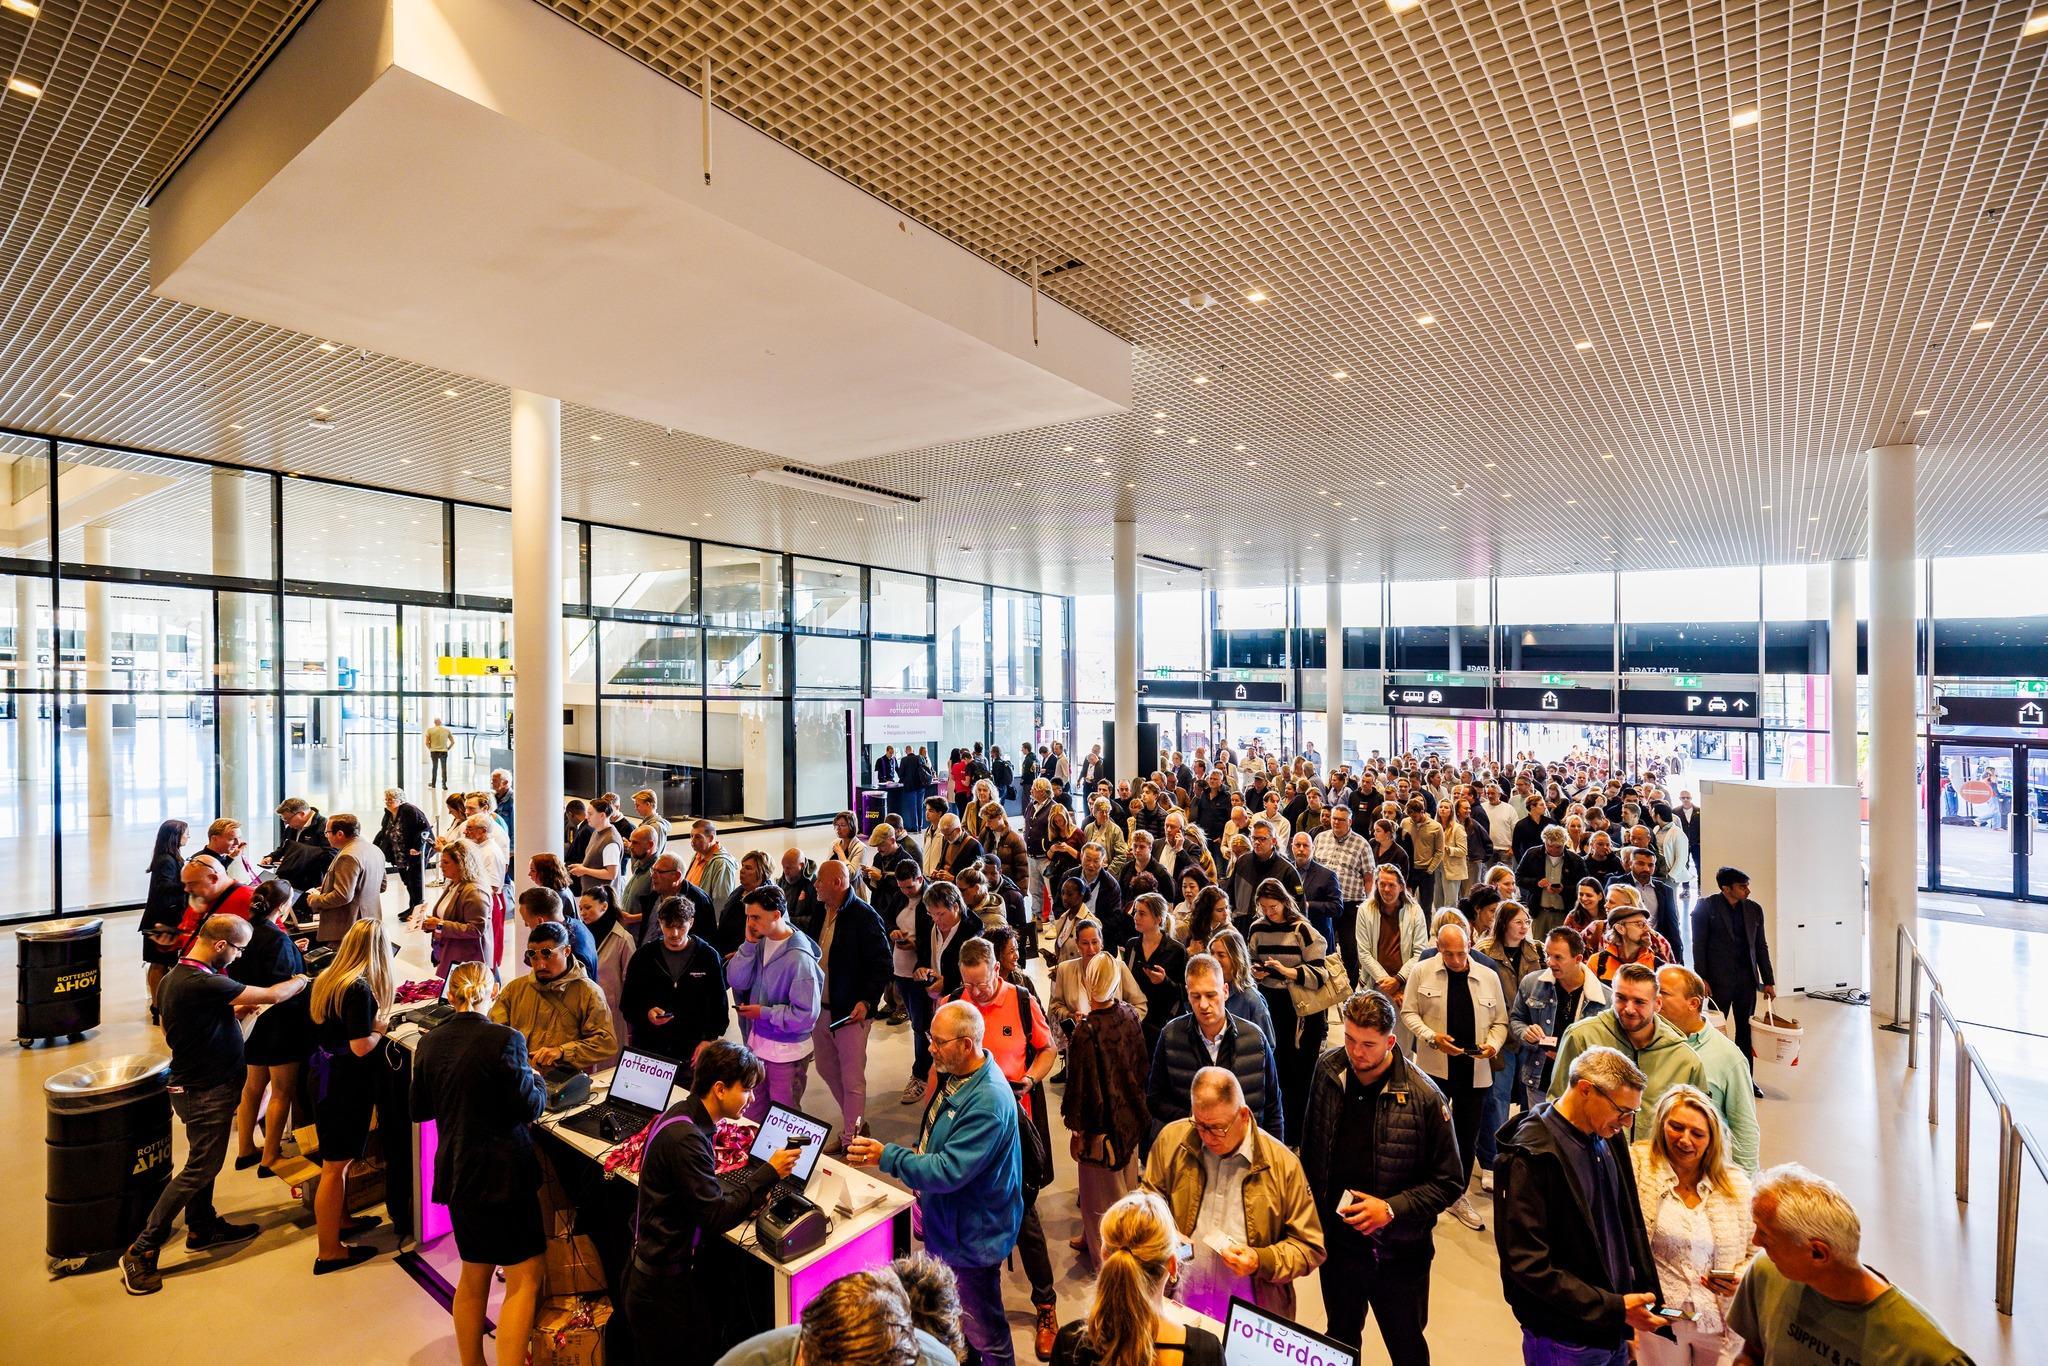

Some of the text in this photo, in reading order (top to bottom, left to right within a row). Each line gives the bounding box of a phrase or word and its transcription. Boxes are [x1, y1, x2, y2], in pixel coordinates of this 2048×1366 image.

[889, 706, 920, 714] rotterdam
[1687, 695, 1702, 712] P
[53, 974, 98, 993] AHOY
[57, 970, 98, 983] ROTTERDAM
[621, 1056, 674, 1081] rotterdam
[132, 1143, 171, 1175] AHO
[1233, 1318, 1337, 1366] rotterda
[1787, 1322, 1831, 1357] SUPPLY
